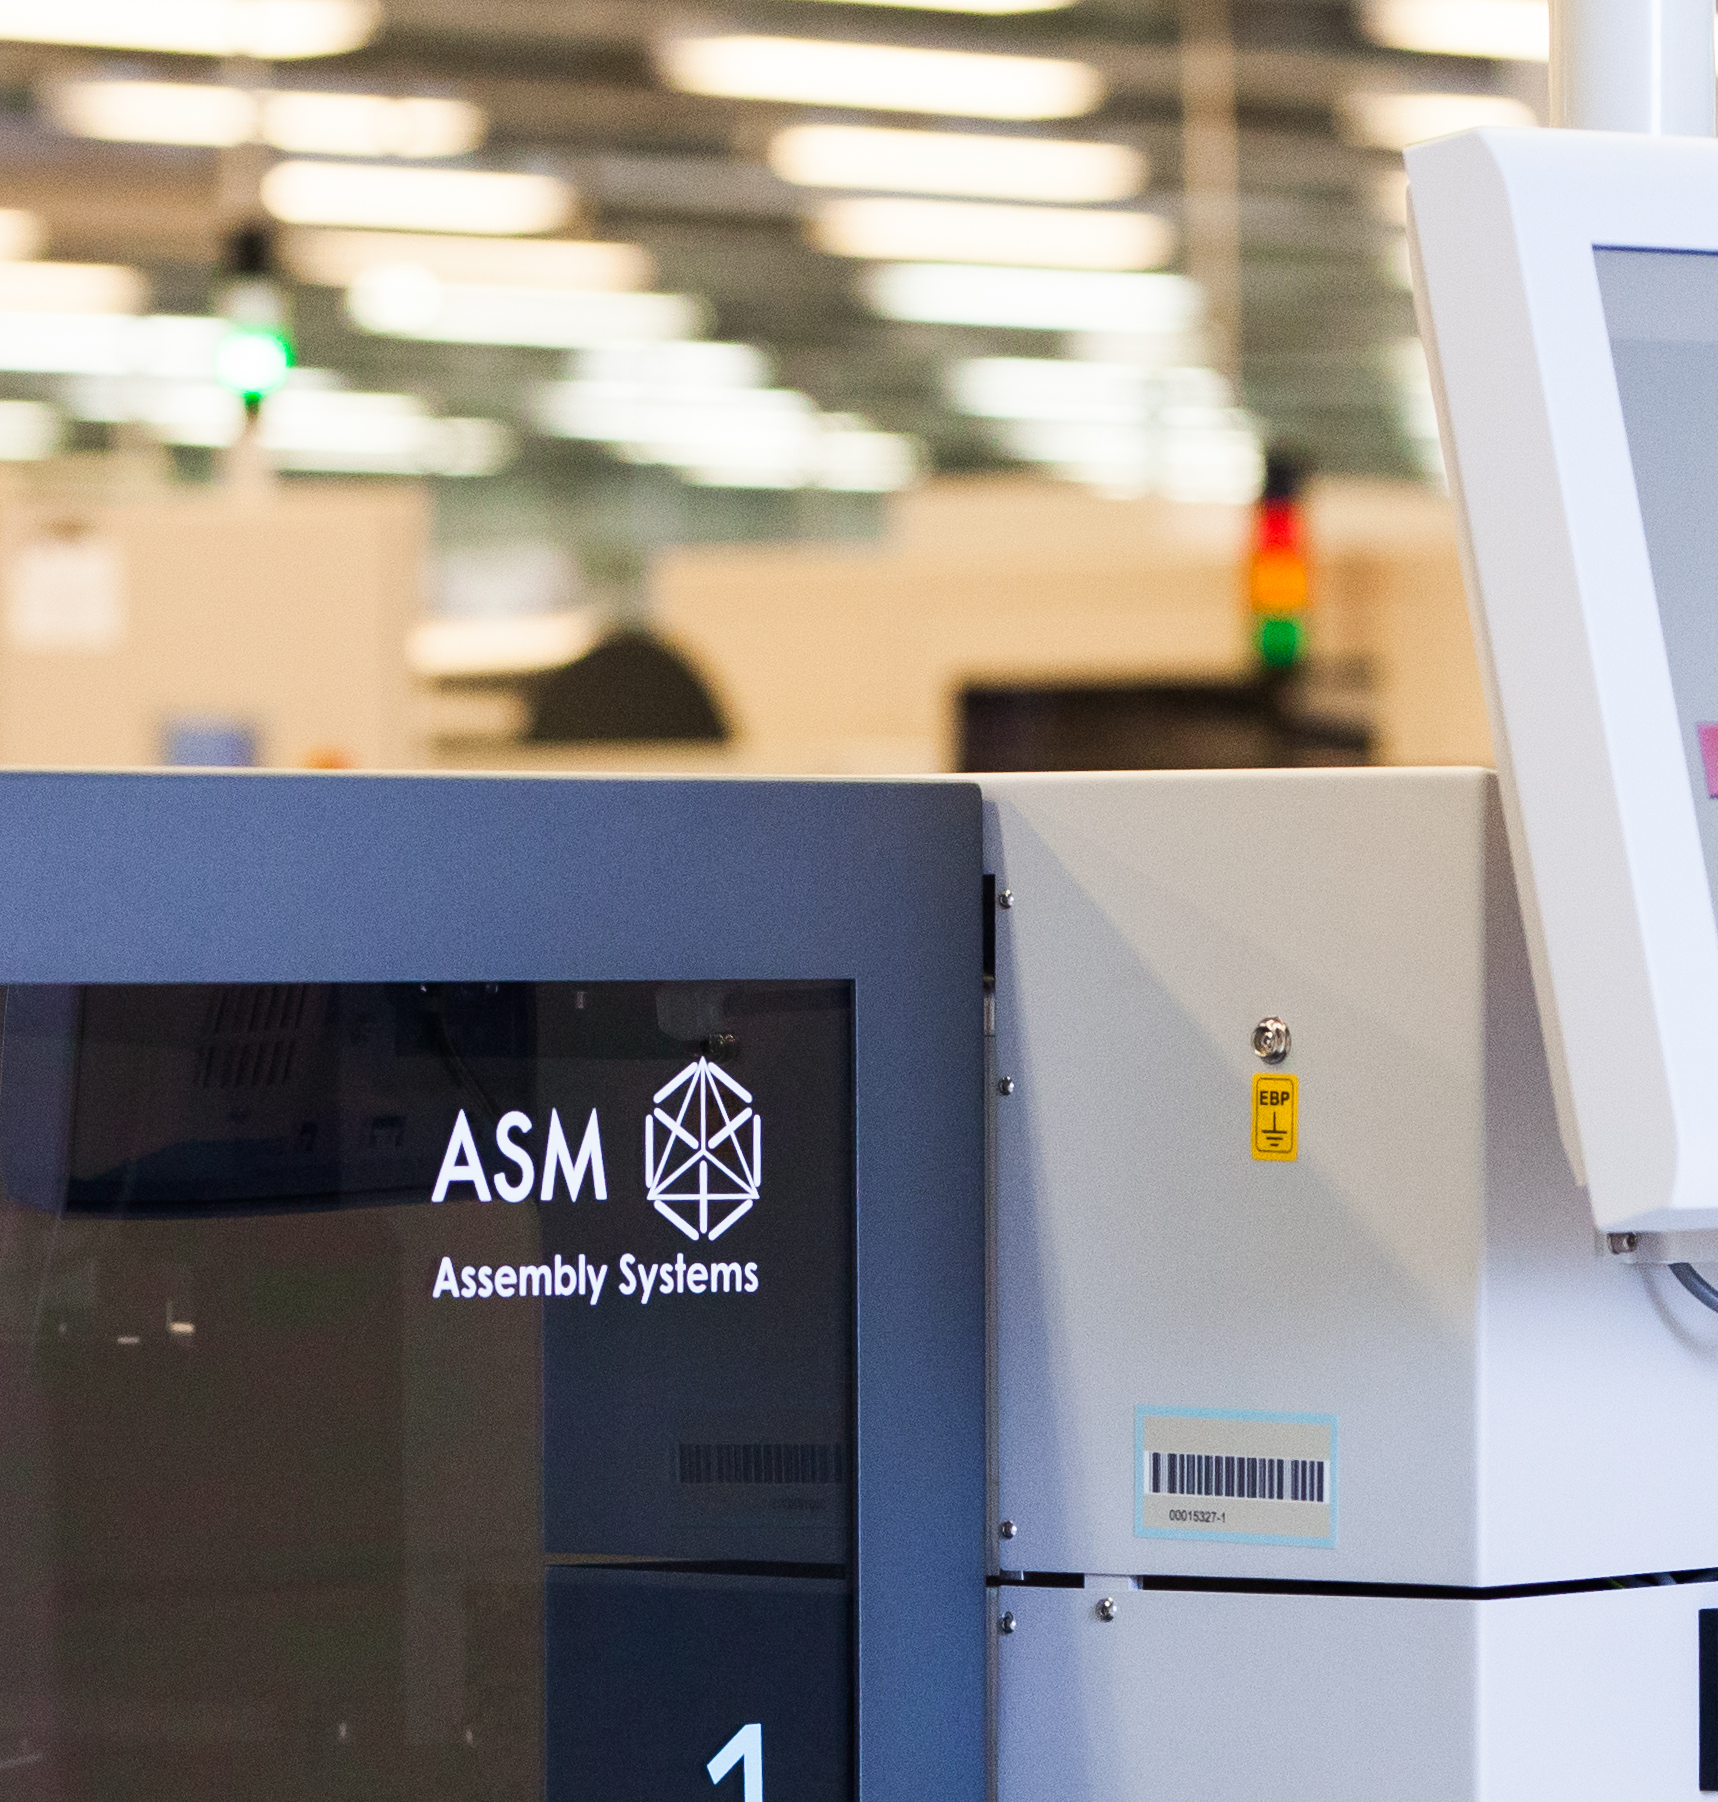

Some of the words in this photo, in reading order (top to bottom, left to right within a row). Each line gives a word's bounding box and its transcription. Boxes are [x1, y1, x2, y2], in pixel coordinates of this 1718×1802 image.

[1259, 1090, 1290, 1106] EBP
[431, 1108, 608, 1203] ASM
[432, 1253, 608, 1305] Assembly
[618, 1252, 759, 1305] Systems
[1169, 1509, 1226, 1523] 00015327-1
